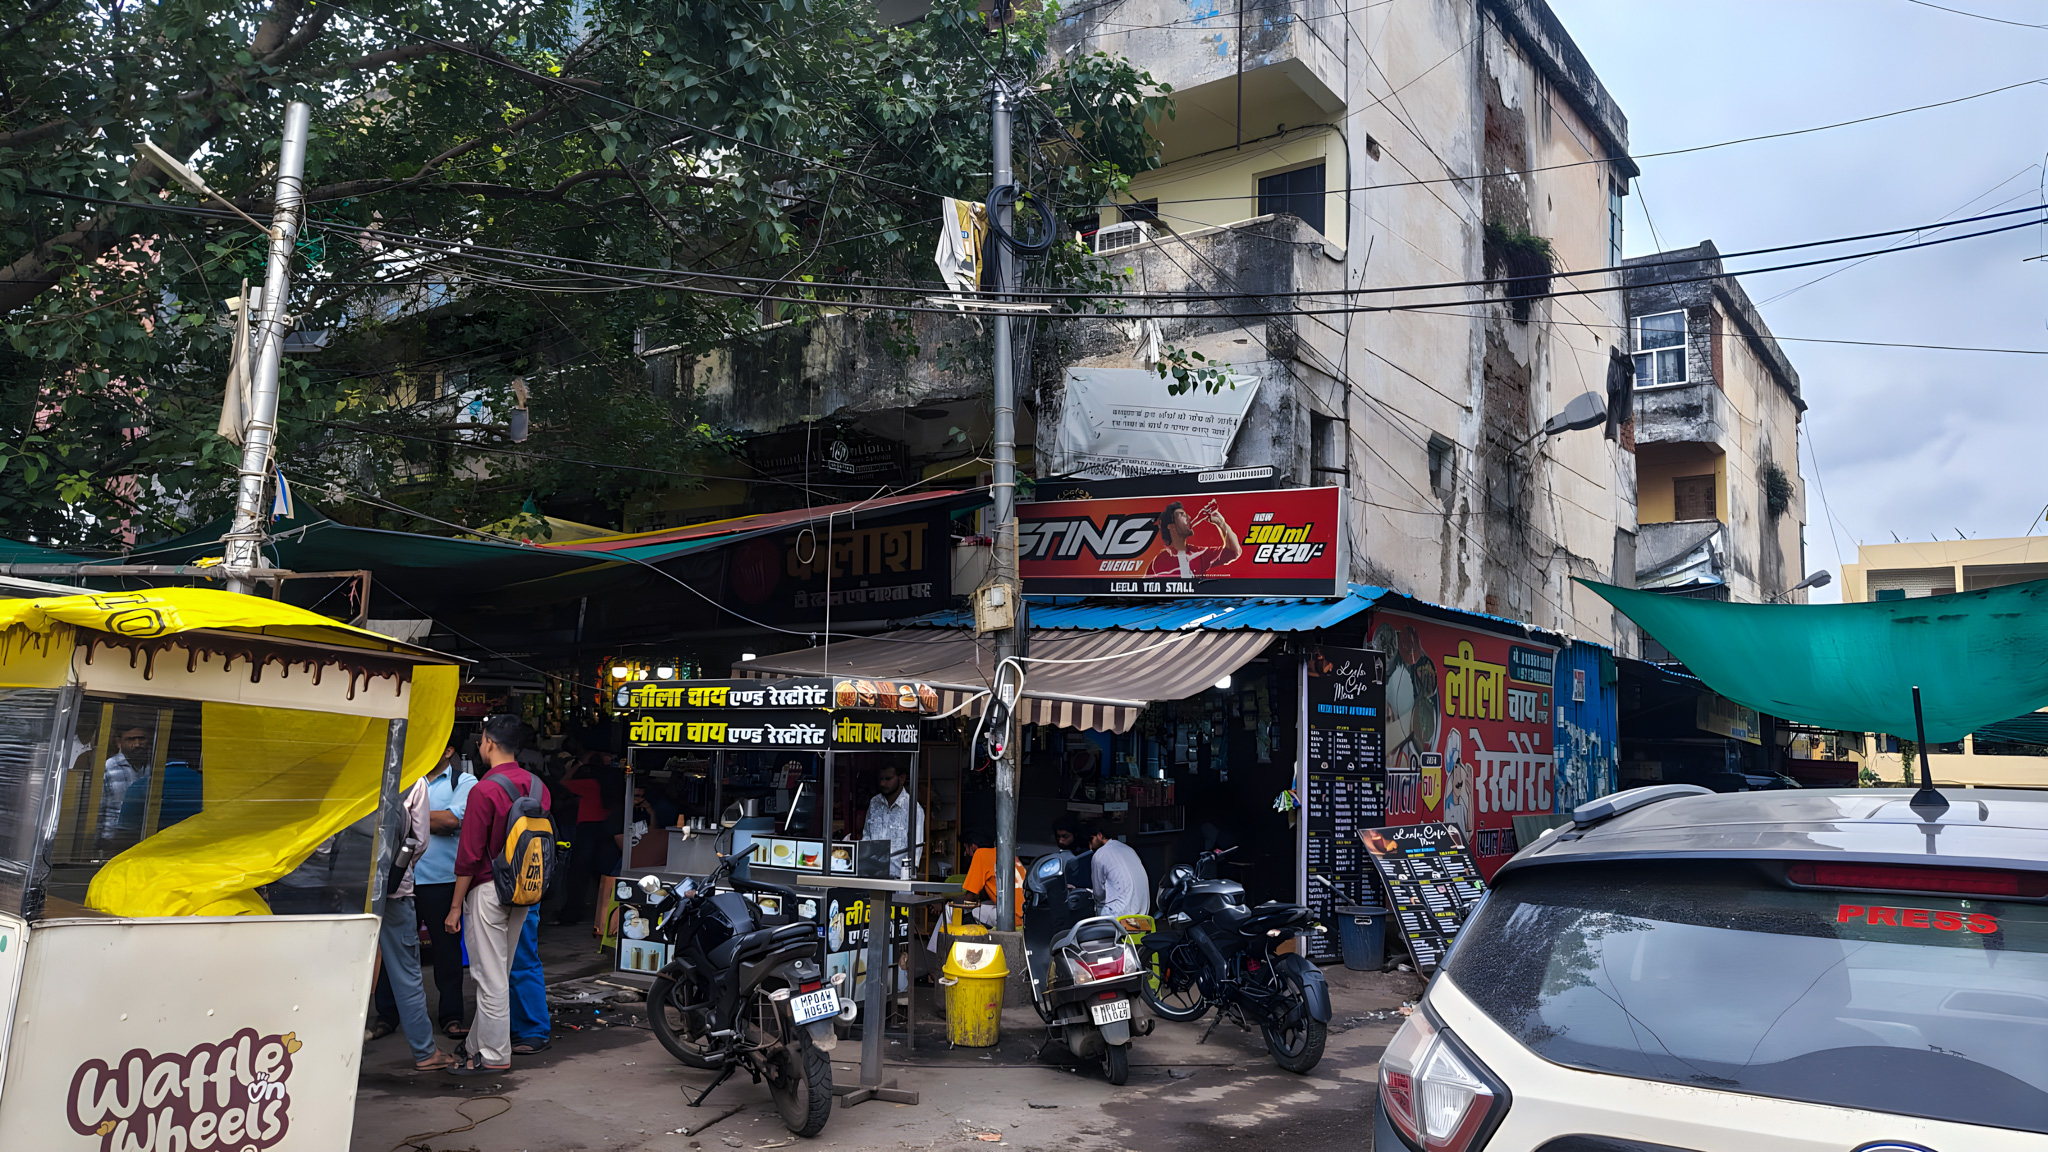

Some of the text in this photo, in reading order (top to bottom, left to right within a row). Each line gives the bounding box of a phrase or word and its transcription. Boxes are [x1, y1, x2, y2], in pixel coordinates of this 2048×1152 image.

[1017, 516, 1156, 557] STING
[1099, 560, 1144, 572] ENERGY
[1165, 581, 1195, 593] STALL
[1444, 640, 1506, 721] लीला
[630, 684, 828, 708] लीला चाय एण्ड रेस्टोरेंट
[1508, 688, 1538, 723] चाय
[630, 717, 825, 744] लीला चाय एण्ड रेस्टोरेंट
[838, 717, 863, 743] लीला
[864, 721, 882, 743] चाय
[1469, 728, 1553, 812] रेस्टोरेंट
[1836, 904, 1998, 934] PRESS
[76, 1035, 286, 1127] Waffle
